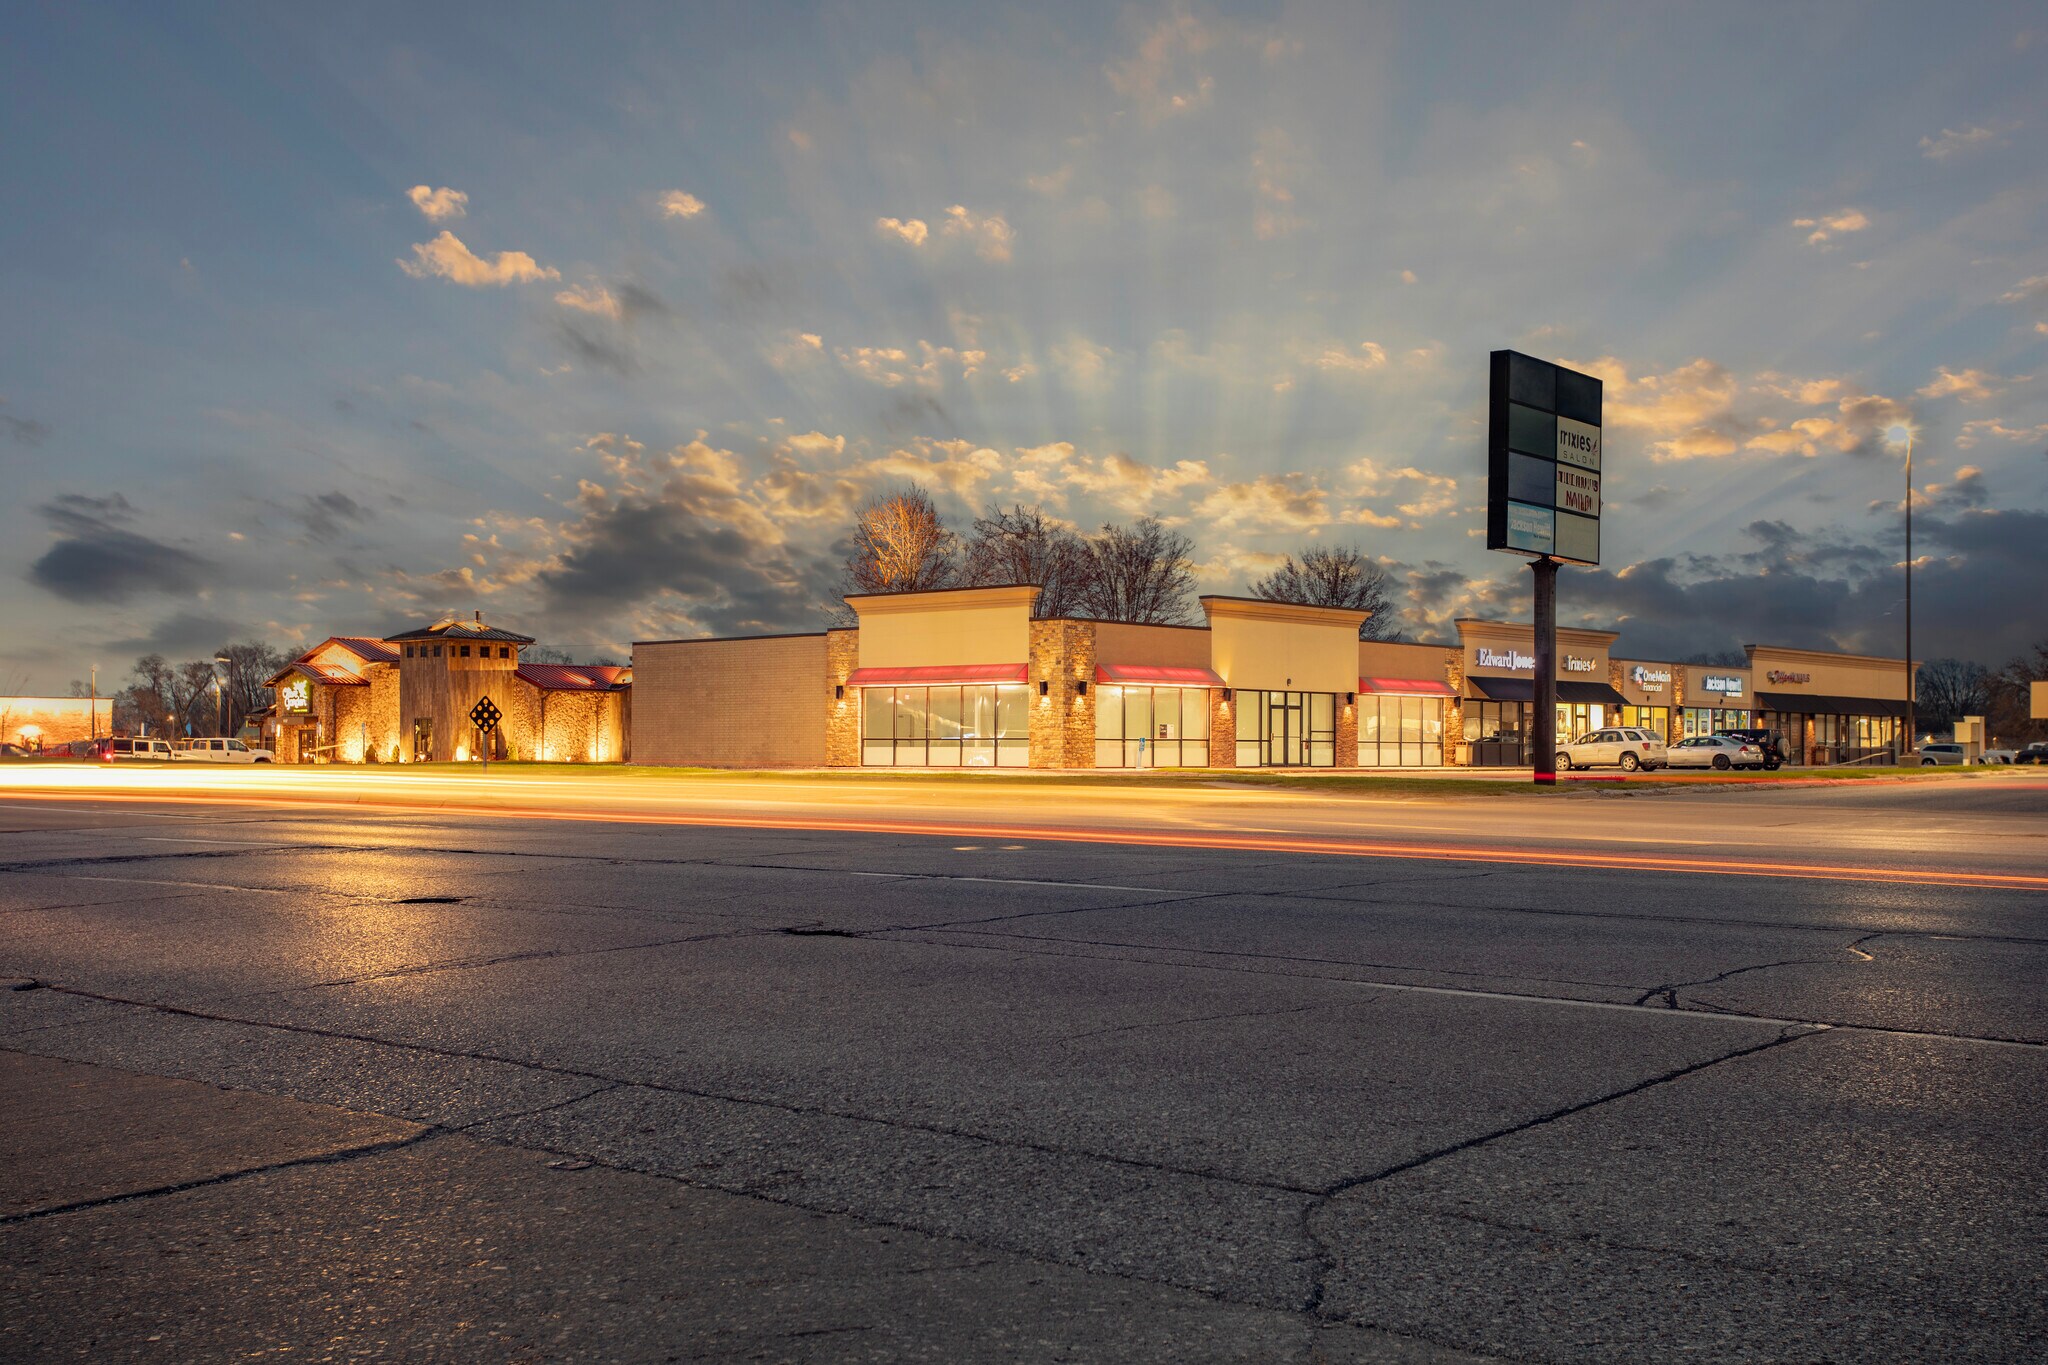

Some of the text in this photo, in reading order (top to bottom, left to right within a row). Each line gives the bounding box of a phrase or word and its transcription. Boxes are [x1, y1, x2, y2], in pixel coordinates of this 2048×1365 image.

[1563, 450, 1594, 465] SALON
[1479, 648, 1512, 667] Edward
[1643, 669, 1671, 682] OneMain
